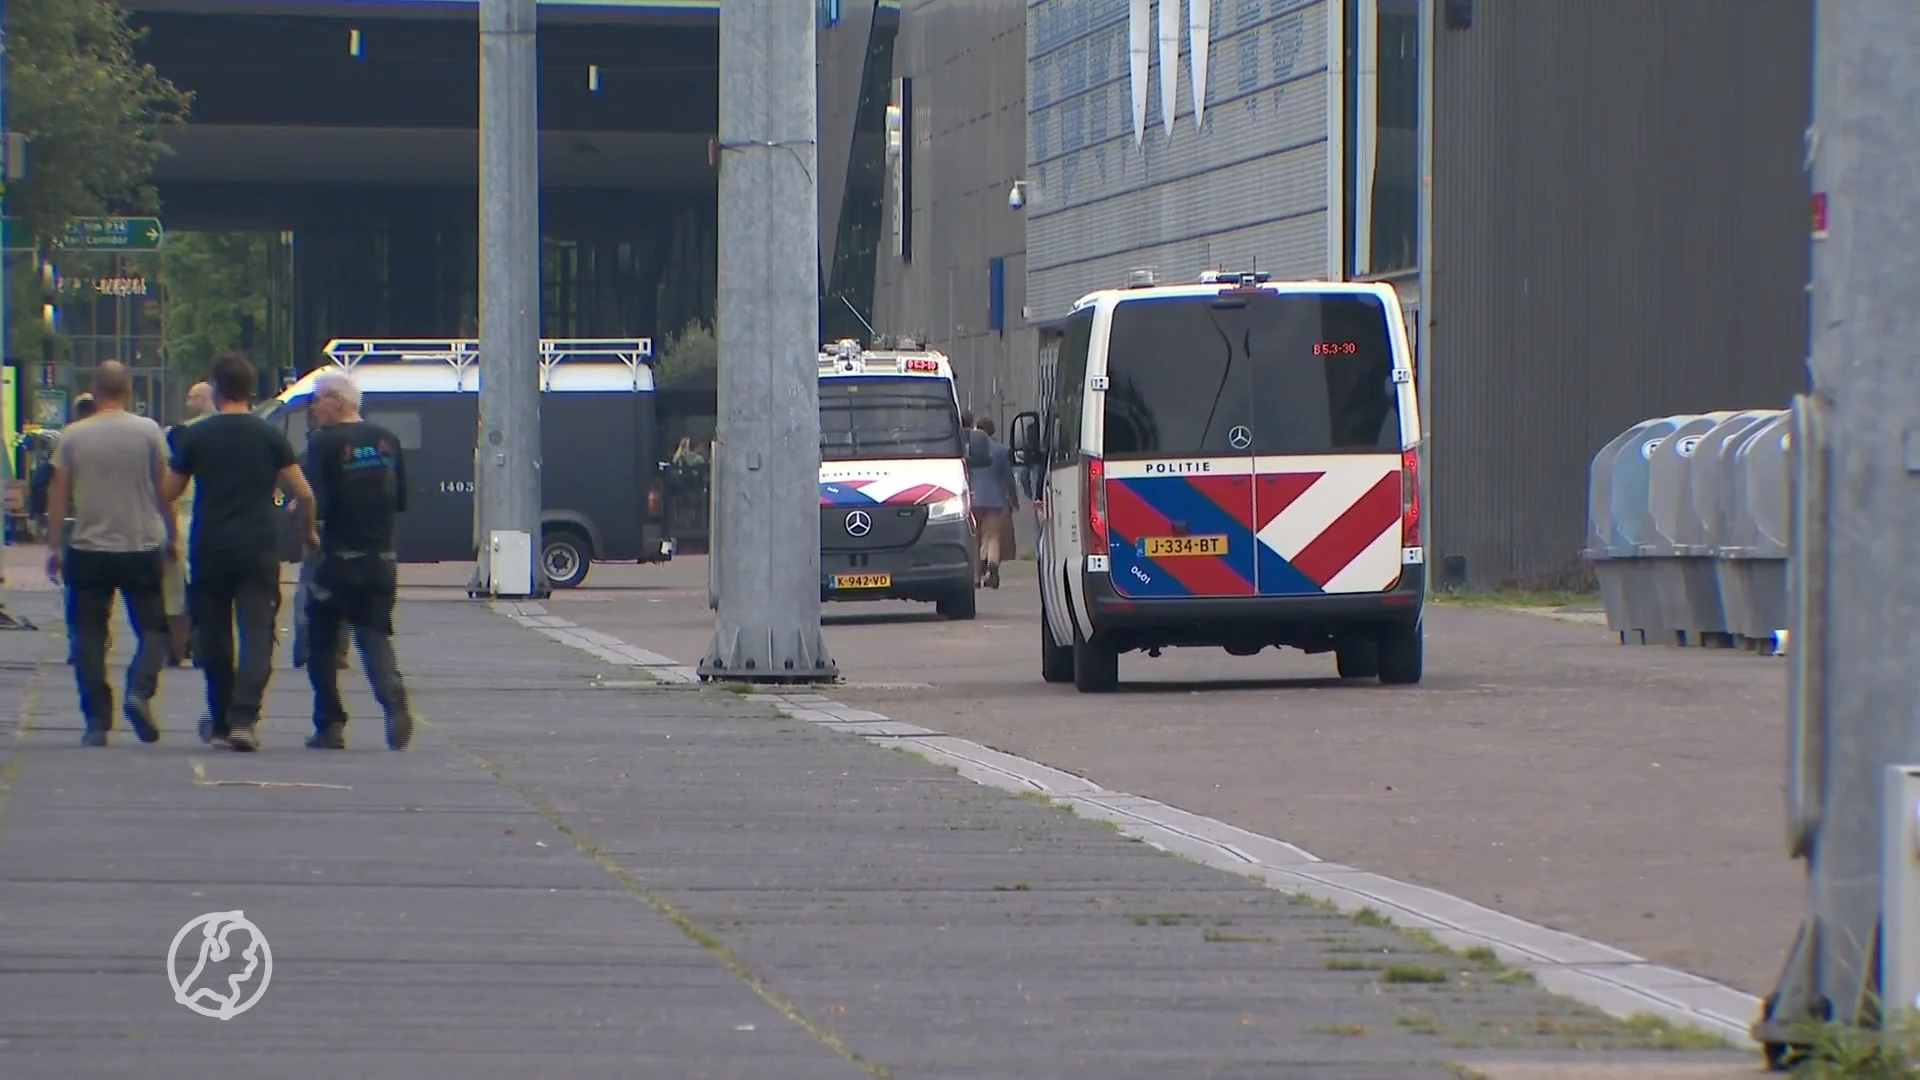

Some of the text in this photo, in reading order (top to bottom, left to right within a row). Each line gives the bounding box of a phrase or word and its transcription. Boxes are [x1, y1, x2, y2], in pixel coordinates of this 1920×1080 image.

[1146, 462, 1211, 473] POLITIE
[1151, 538, 1219, 554] J-334-BT
[837, 575, 888, 586] K-942-VD
[1130, 565, 1151, 585] 0401
